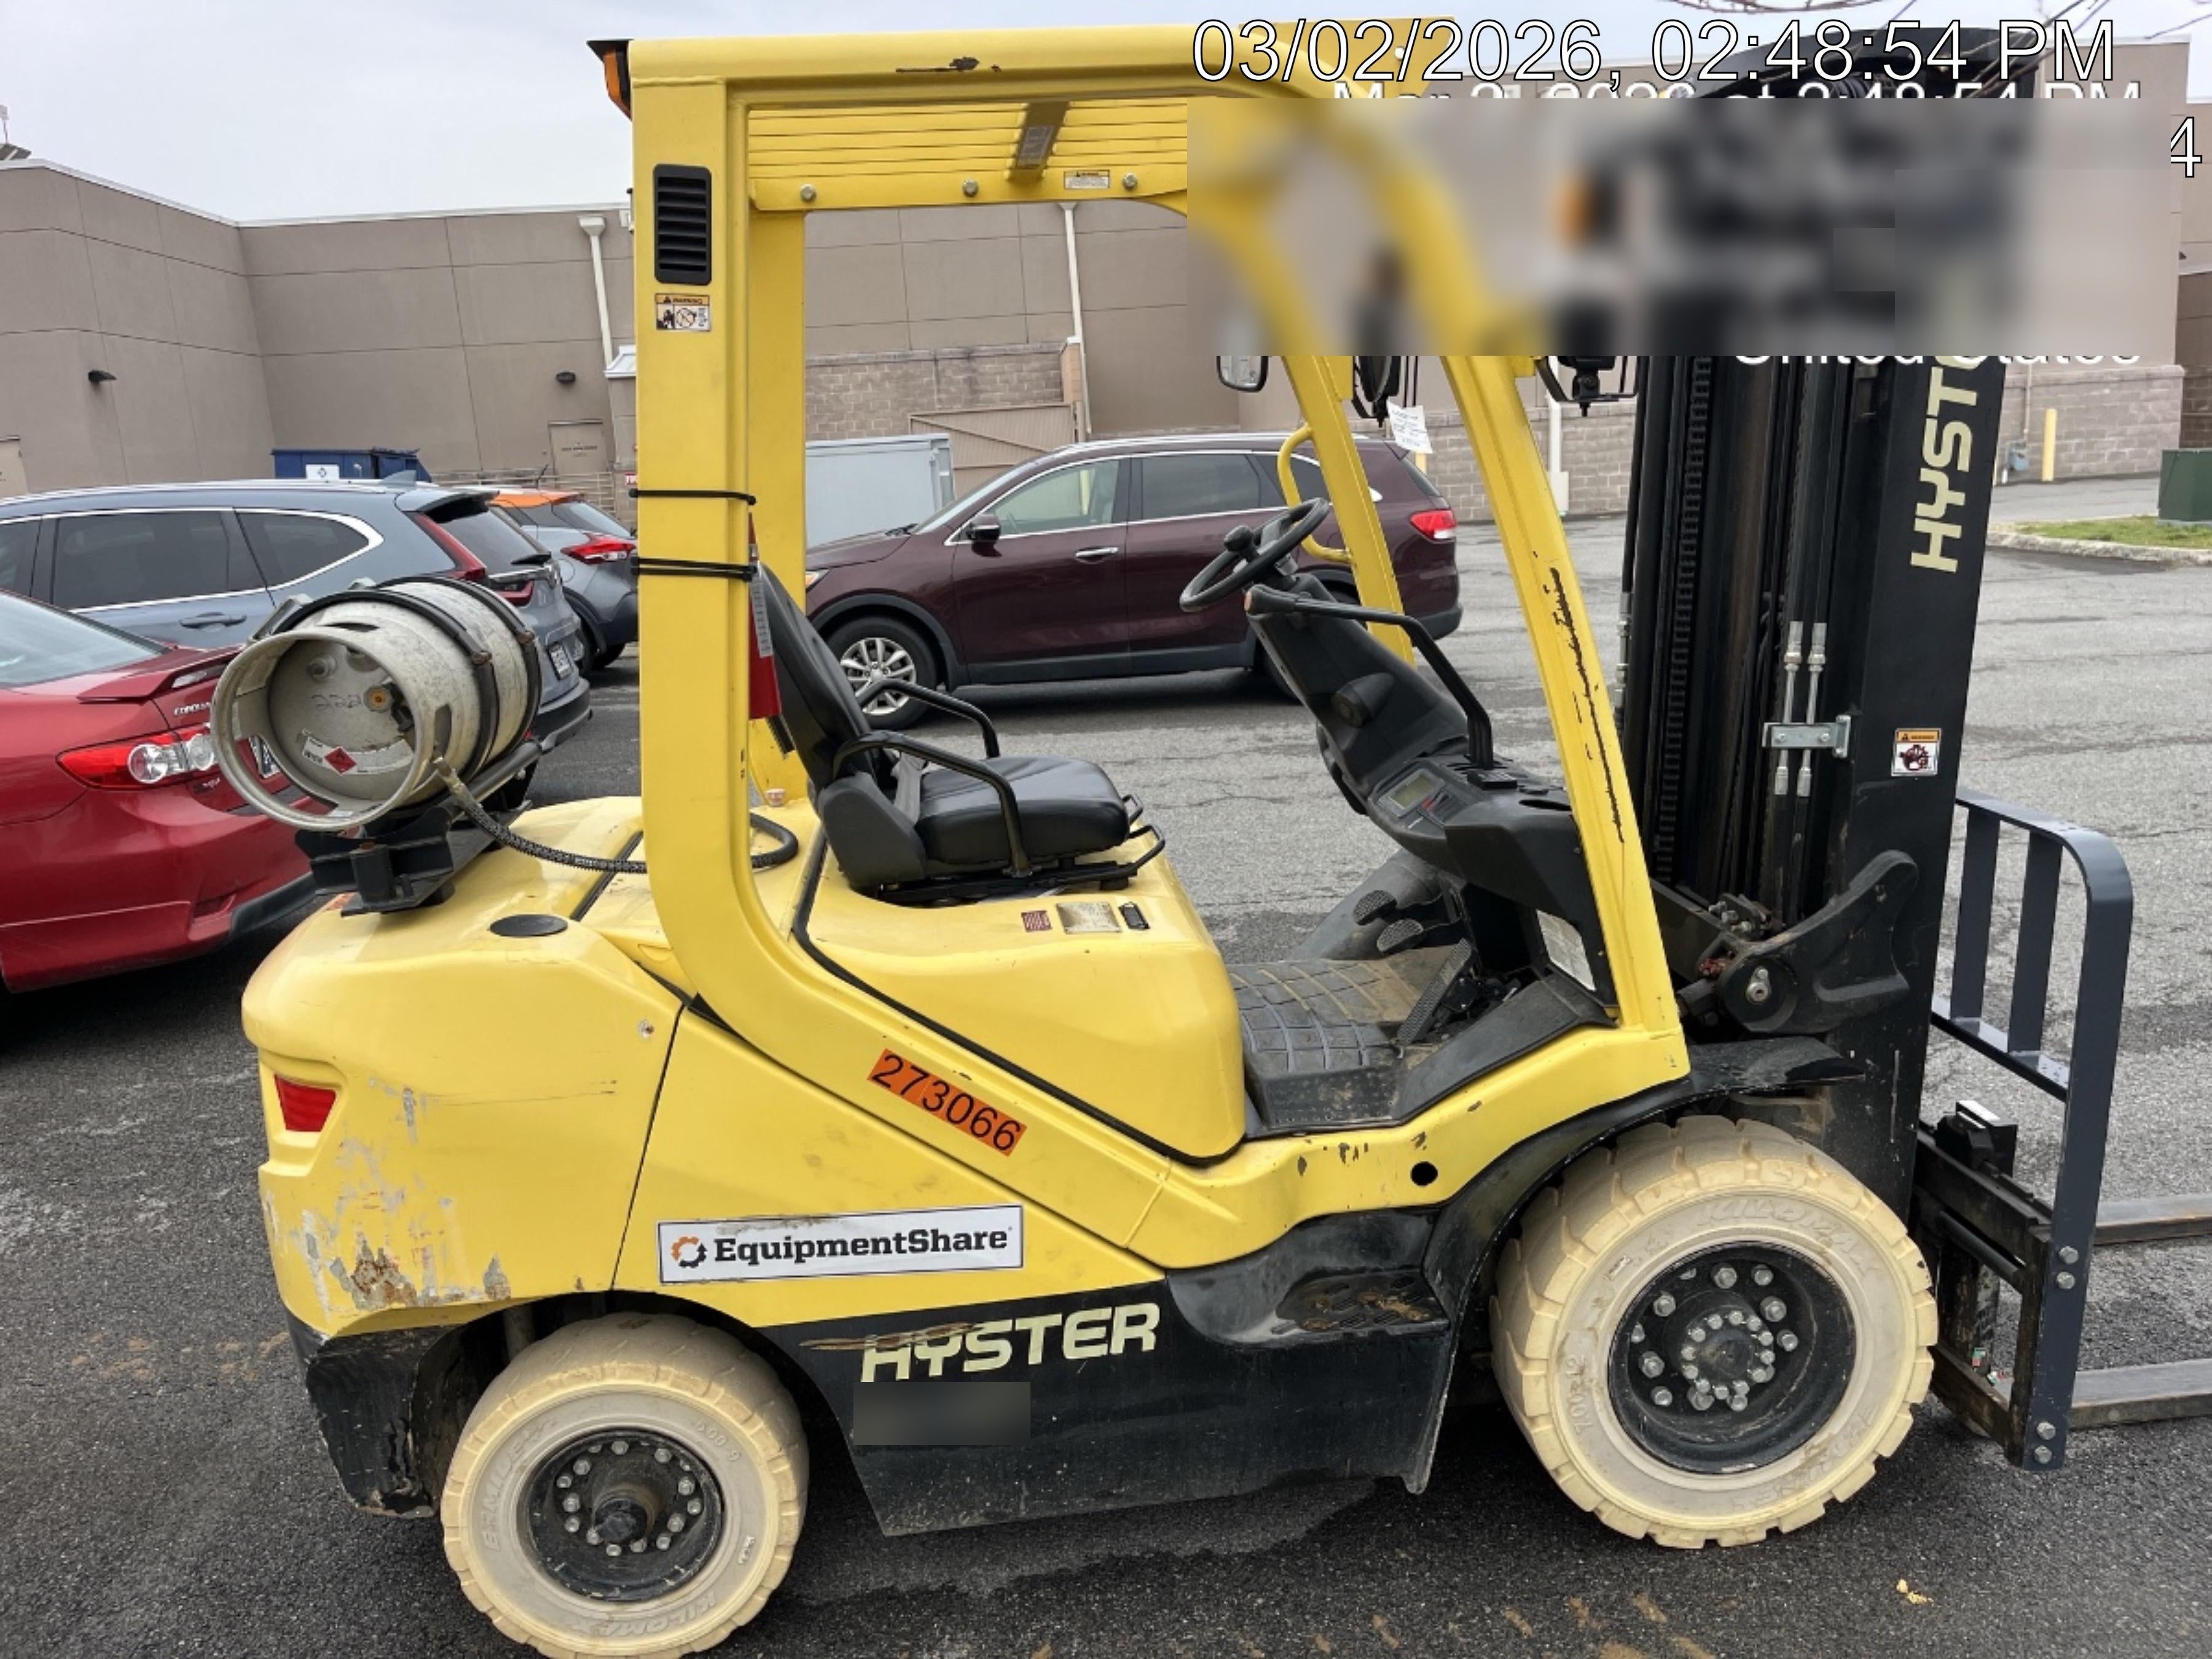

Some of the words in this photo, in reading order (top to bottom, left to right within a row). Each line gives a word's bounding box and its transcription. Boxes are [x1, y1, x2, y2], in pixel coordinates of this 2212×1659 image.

[871, 1053, 1022, 1151] 273066
[713, 1228, 1008, 1266] EquipmentShare
[860, 1303, 1161, 1382] HYSTER
